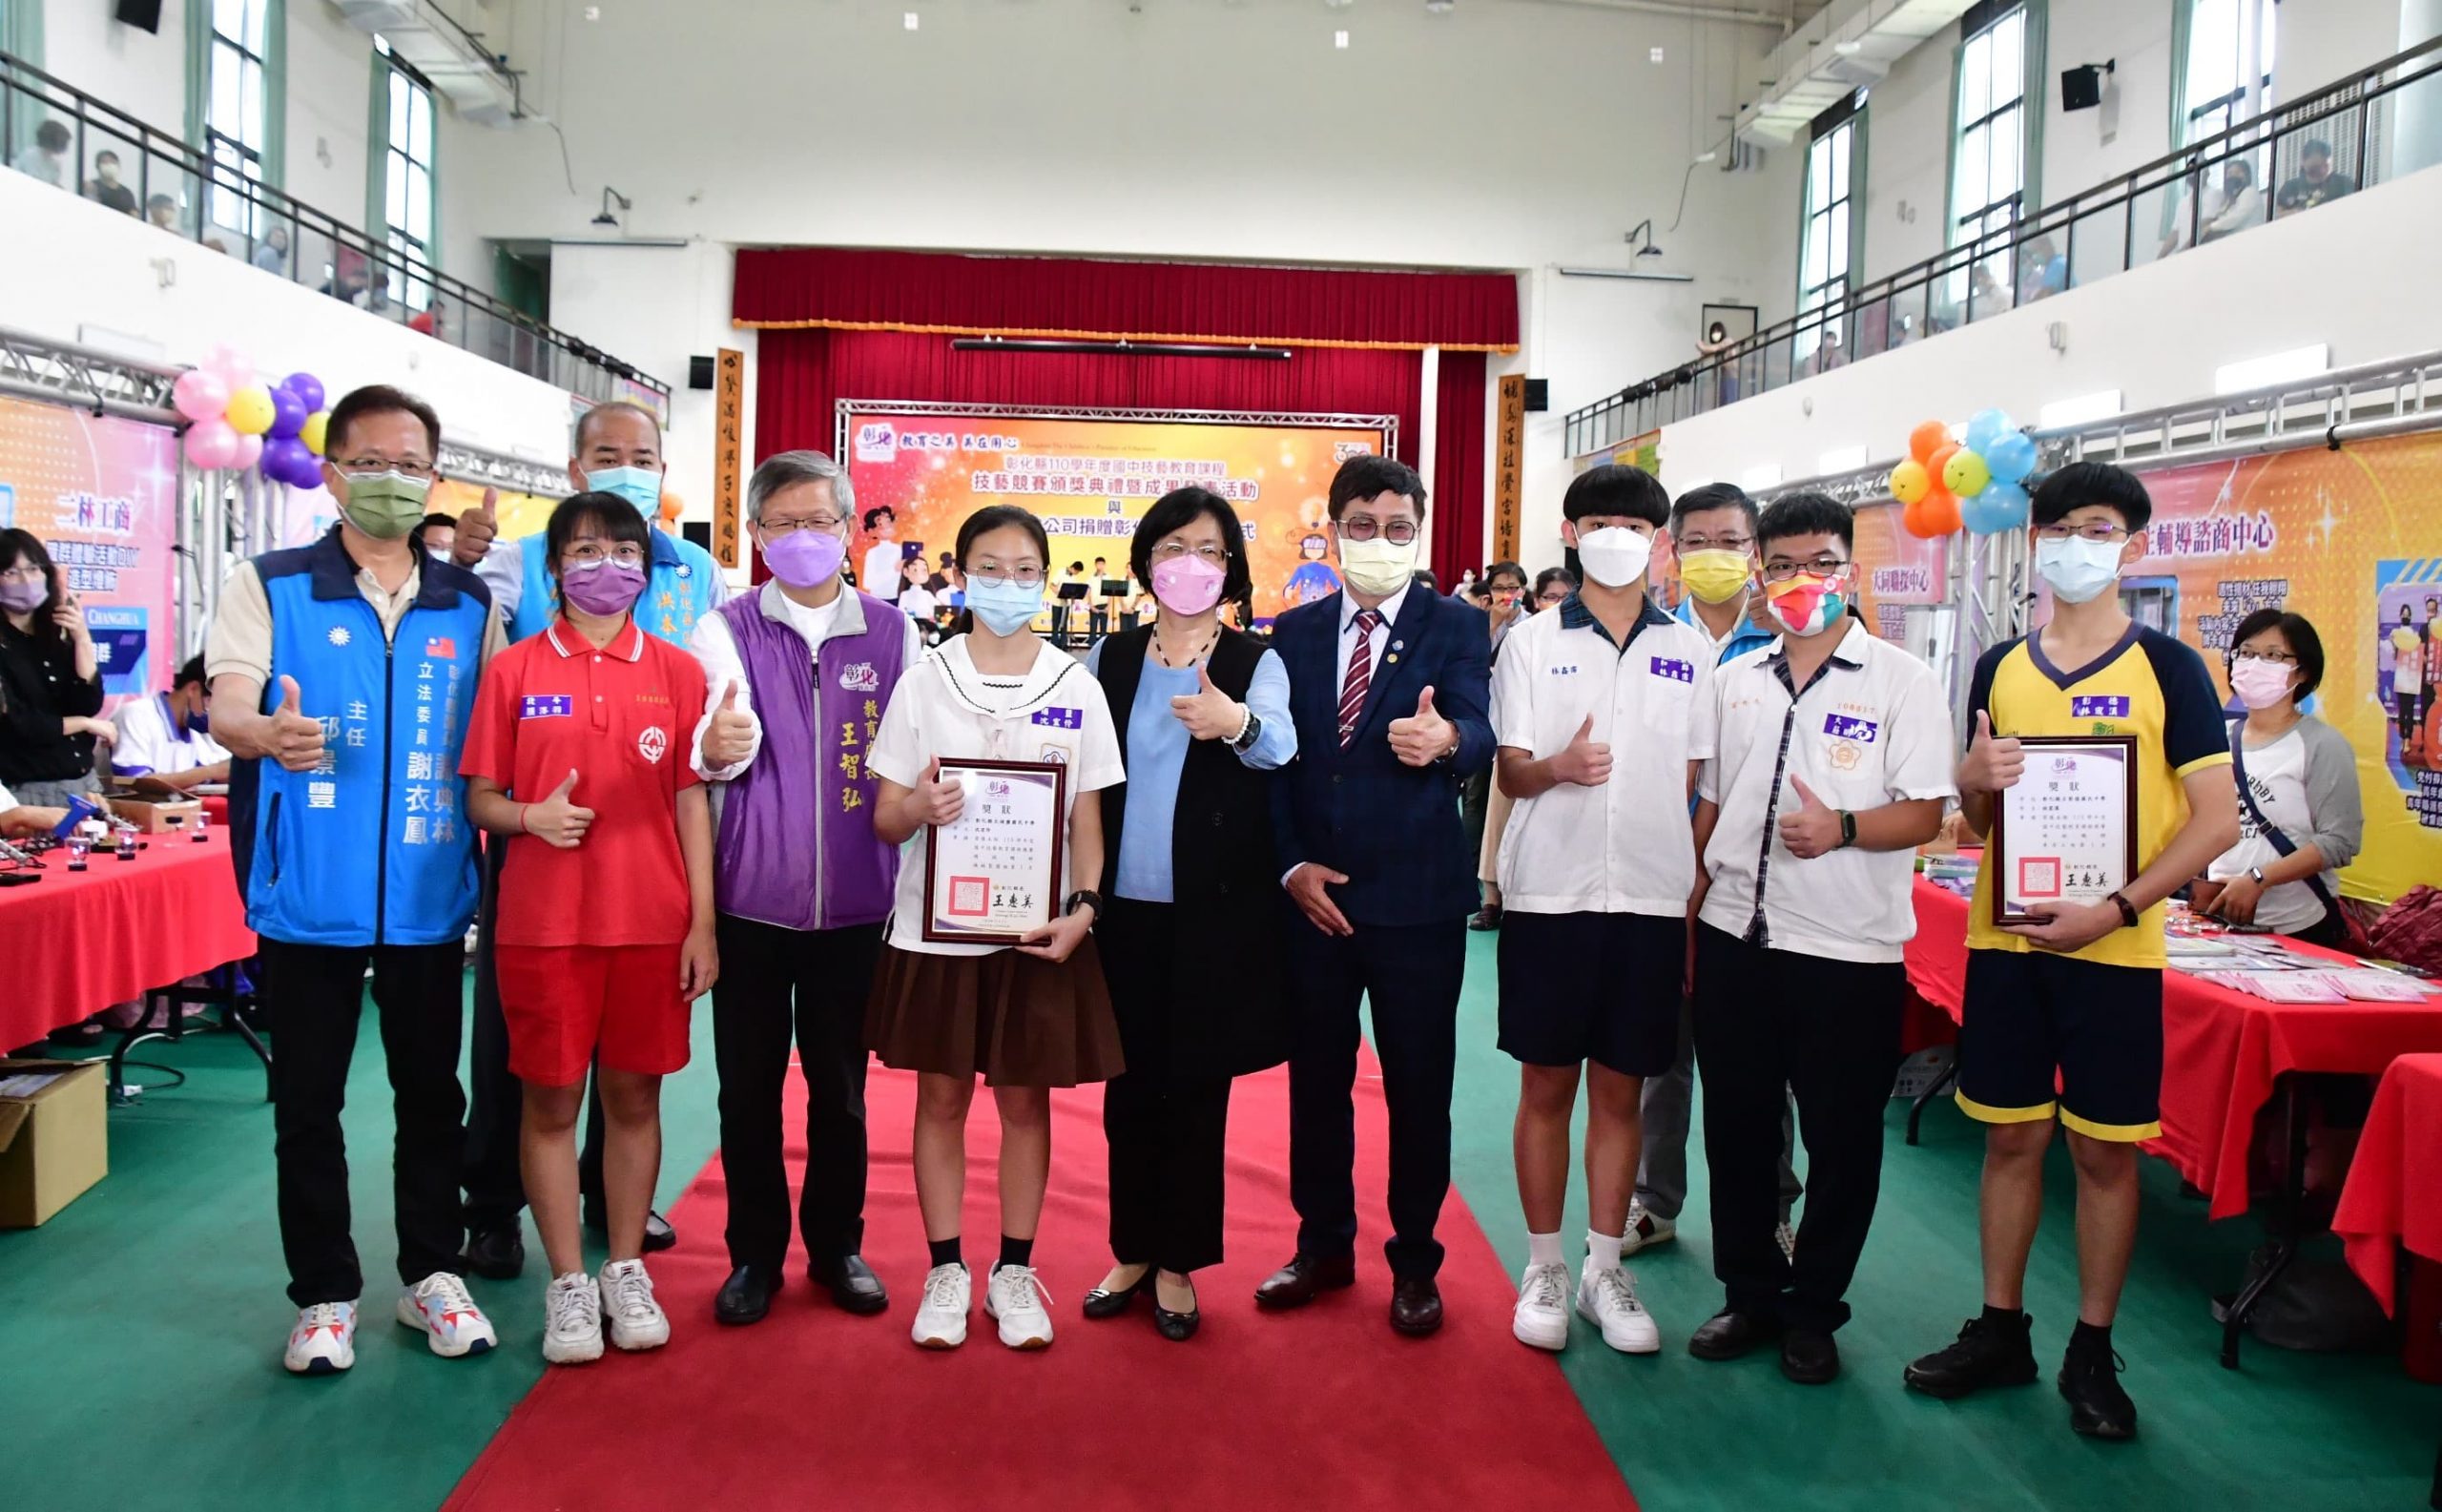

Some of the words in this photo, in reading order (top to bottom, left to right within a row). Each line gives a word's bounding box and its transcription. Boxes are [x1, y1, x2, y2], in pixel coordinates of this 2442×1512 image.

[1006, 457, 1225, 476] 彰化縣110學年度國中技藝教育課程
[57, 495, 131, 530] 二林工商
[1107, 501, 1121, 514] 與
[346, 700, 367, 747] 主任
[416, 662, 434, 746] 立法委員
[839, 722, 863, 813] 王智弘
